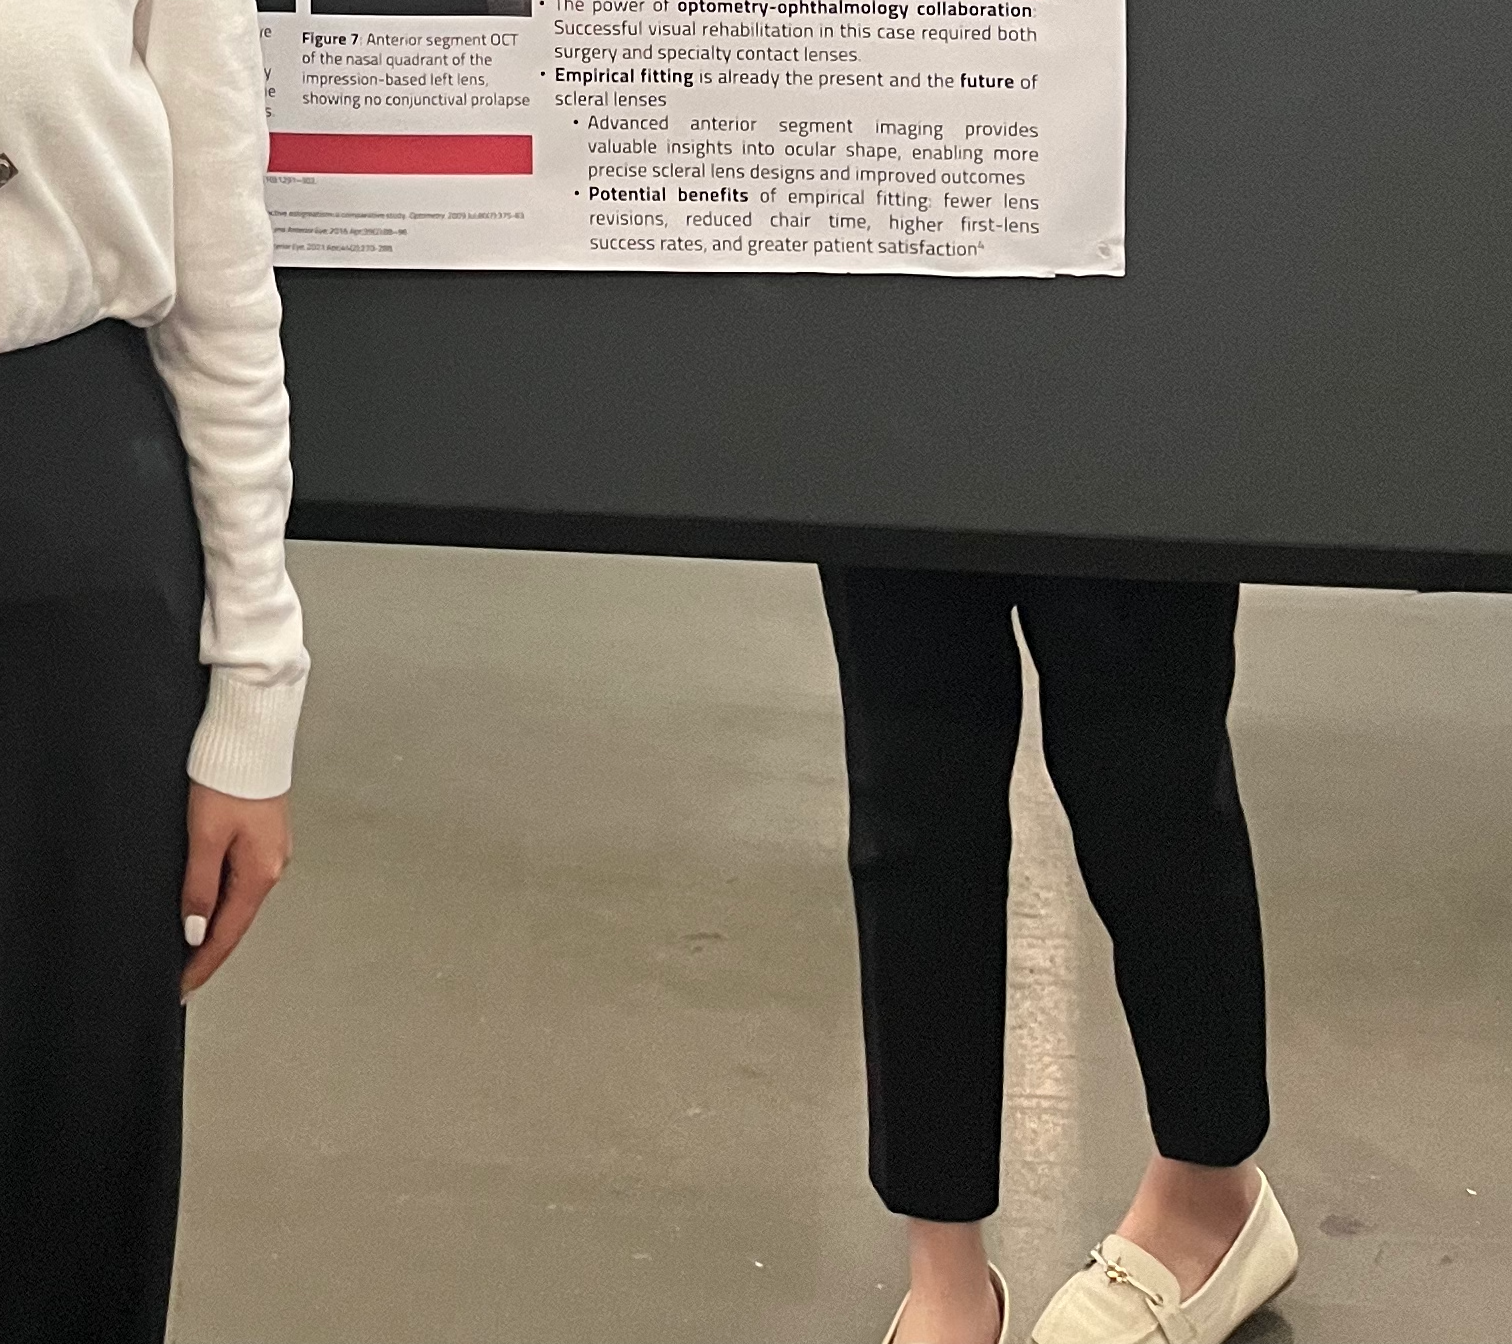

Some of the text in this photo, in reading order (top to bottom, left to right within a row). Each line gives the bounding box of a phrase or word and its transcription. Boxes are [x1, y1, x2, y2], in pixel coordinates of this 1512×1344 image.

[592, 0, 645, 16] power
[302, 31, 347, 49] Figure
[366, 32, 423, 47] Anterior
[425, 34, 487, 50] segment
[490, 32, 519, 47] OCT
[589, 210, 1040, 236] revisions, reduced chair time, higher first-lens
